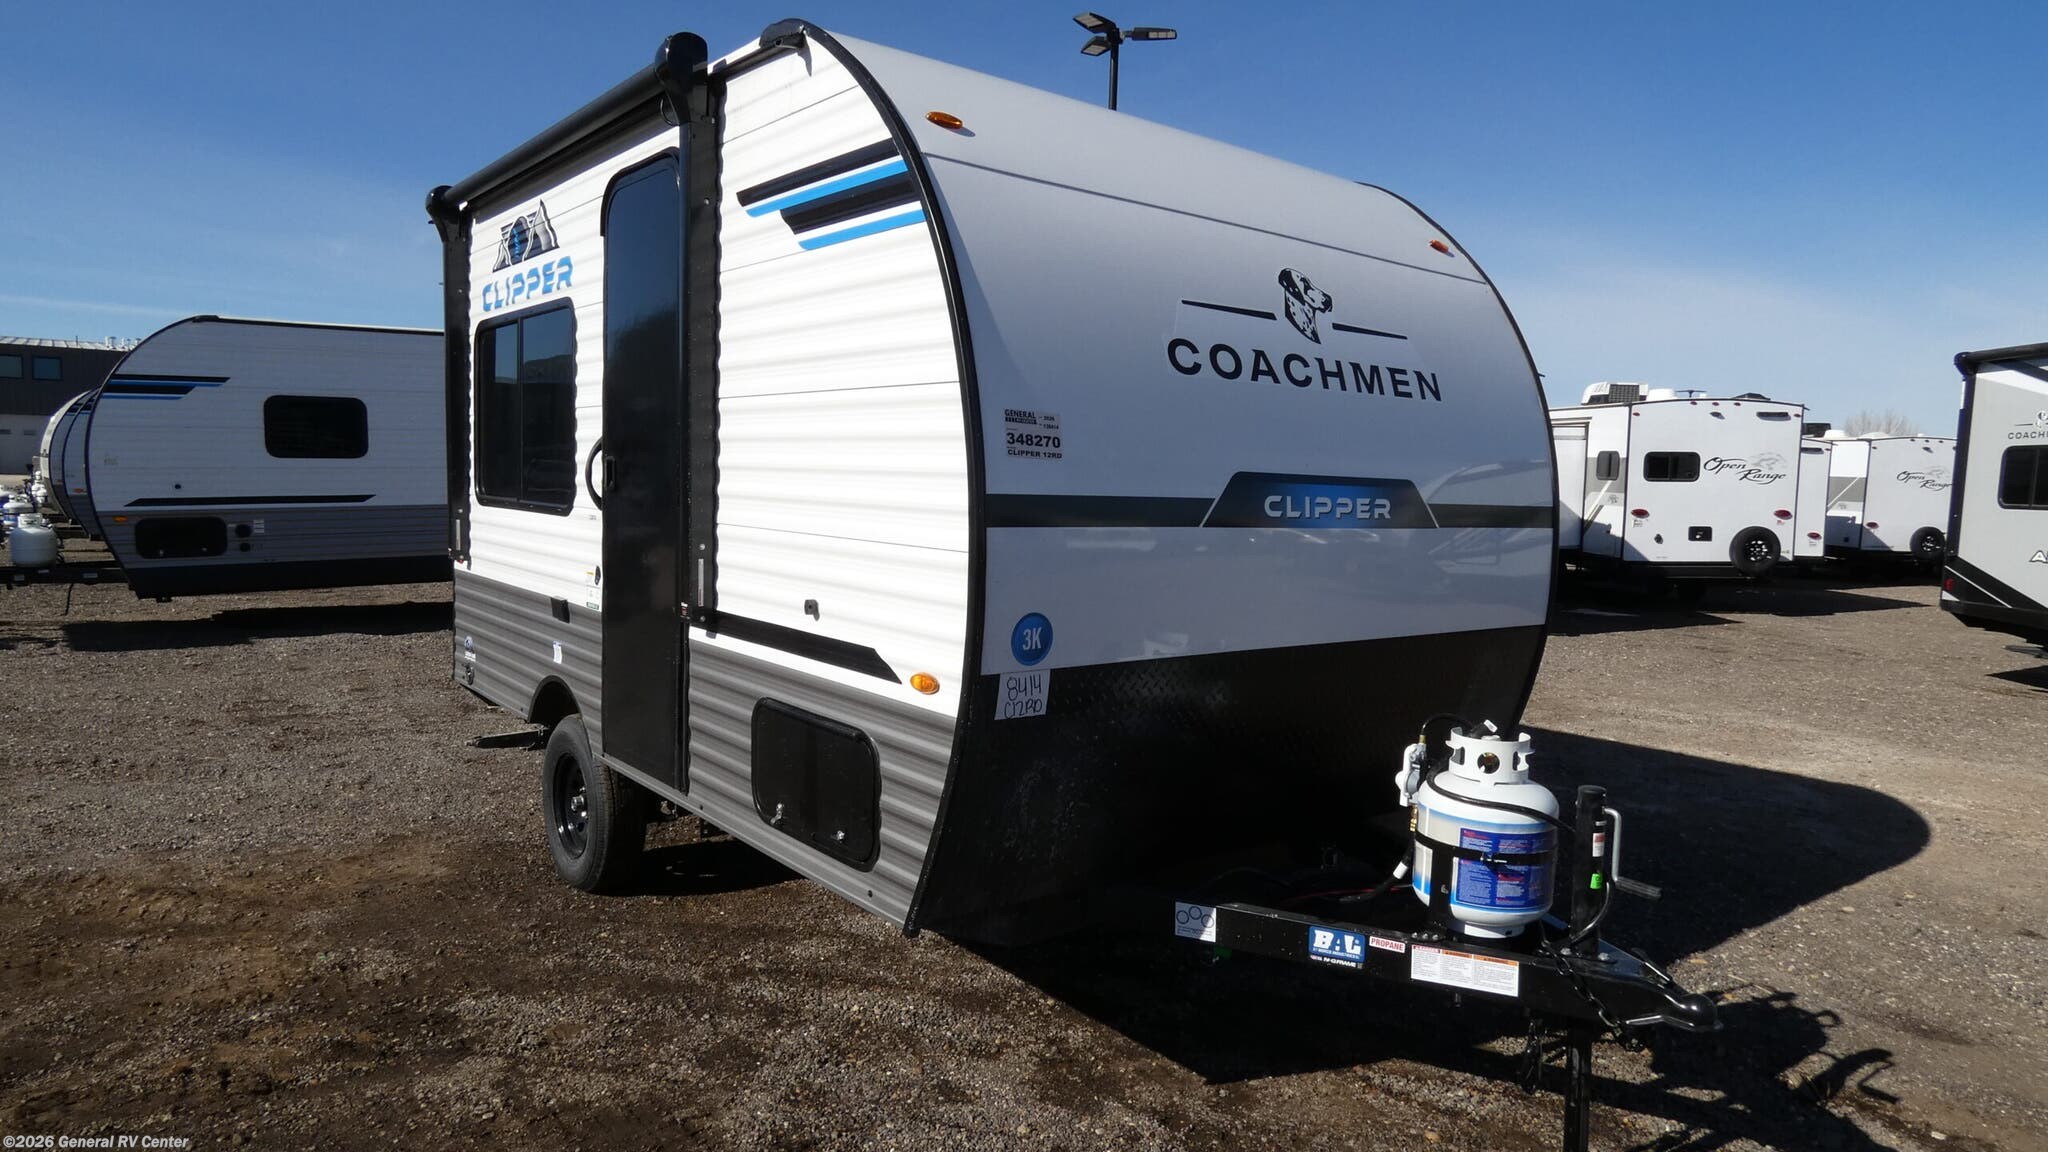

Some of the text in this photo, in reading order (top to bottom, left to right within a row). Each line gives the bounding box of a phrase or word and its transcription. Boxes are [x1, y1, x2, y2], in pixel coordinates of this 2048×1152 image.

[482, 255, 573, 312] CLIPPER
[1167, 338, 1442, 401] COACHMEN
[1004, 409, 1036, 419] GENERAL
[1006, 432, 1061, 449] 348270
[2007, 431, 2048, 440] COACH
[1007, 449, 1041, 458] CLIPPER
[1703, 457, 1747, 475] Open
[1736, 469, 1786, 485] Range
[1896, 471, 1925, 483] Open
[1264, 495, 1392, 519] CLIPPER
[1022, 627, 1042, 651] 3K
[1007, 674, 1042, 701] 8414
[1370, 937, 1404, 951] PROPANE
